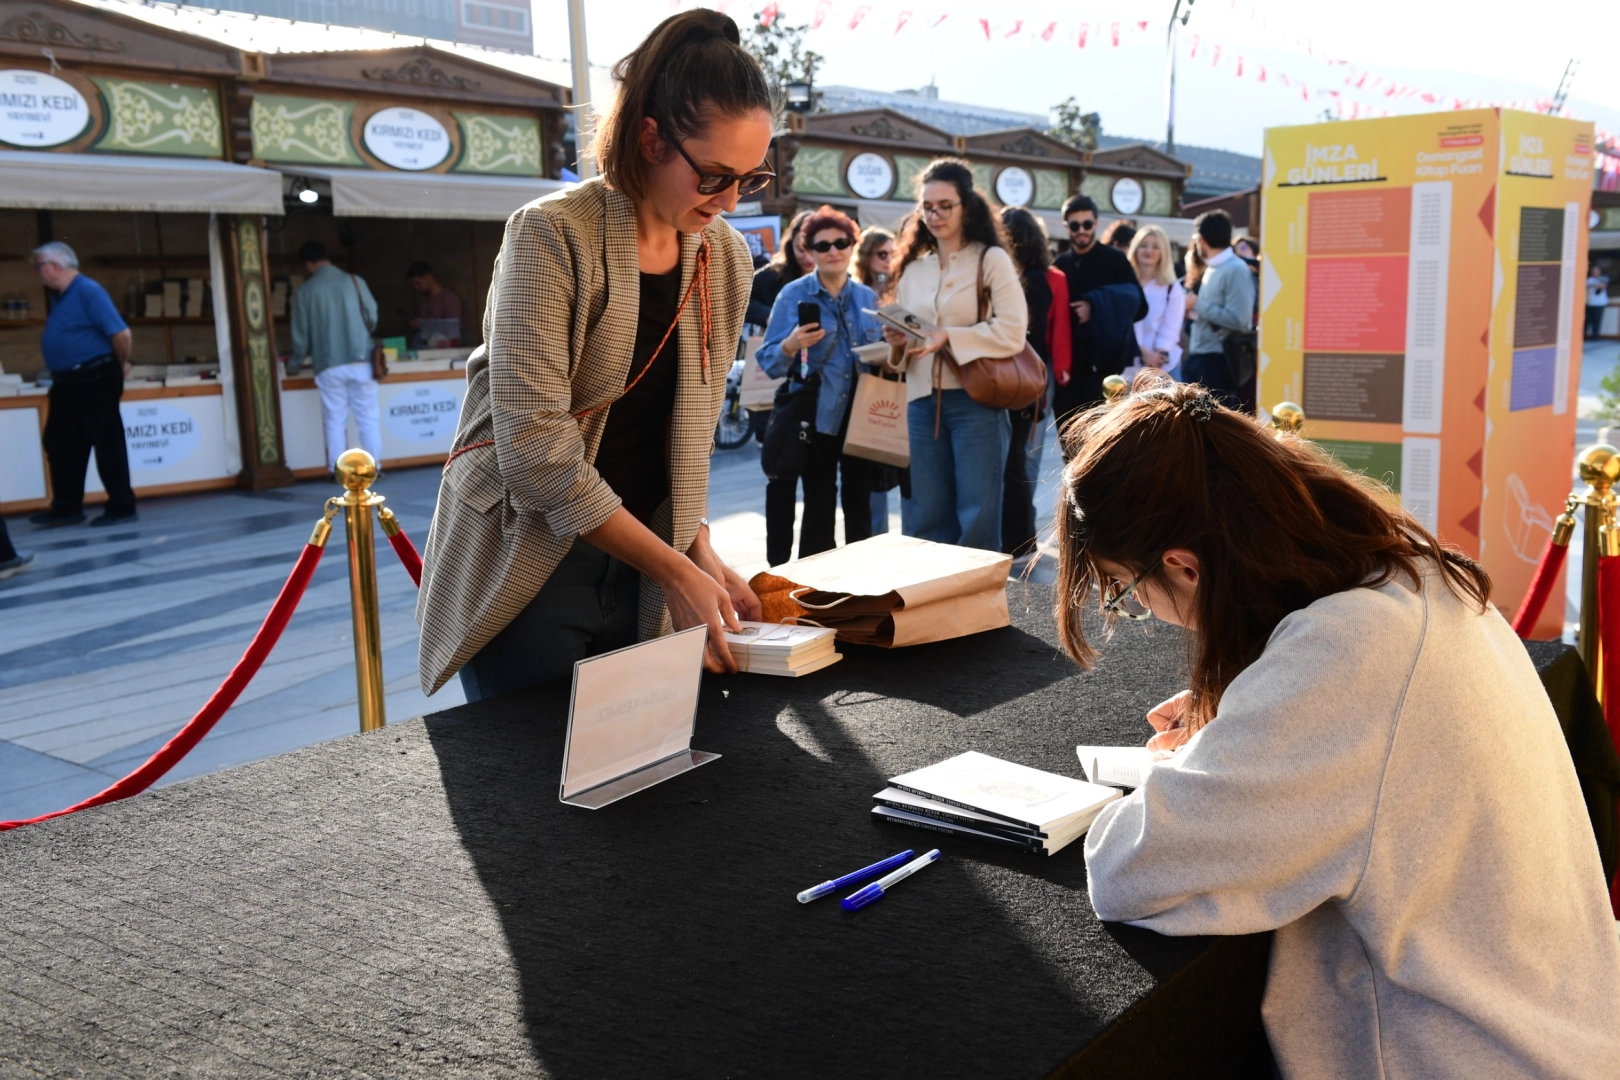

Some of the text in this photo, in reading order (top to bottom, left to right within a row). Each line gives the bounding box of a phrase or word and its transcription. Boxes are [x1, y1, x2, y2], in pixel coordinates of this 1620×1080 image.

[0, 93, 78, 110] MIZI KEDİ
[372, 124, 442, 142] KIRMIZI KEDİ
[1306, 143, 1358, 163] İMZA
[1287, 158, 1378, 185] GÜNLERİ
[390, 398, 456, 417] KIRMIZI KEDİ
[126, 418, 193, 438] MIZI KEDİ
